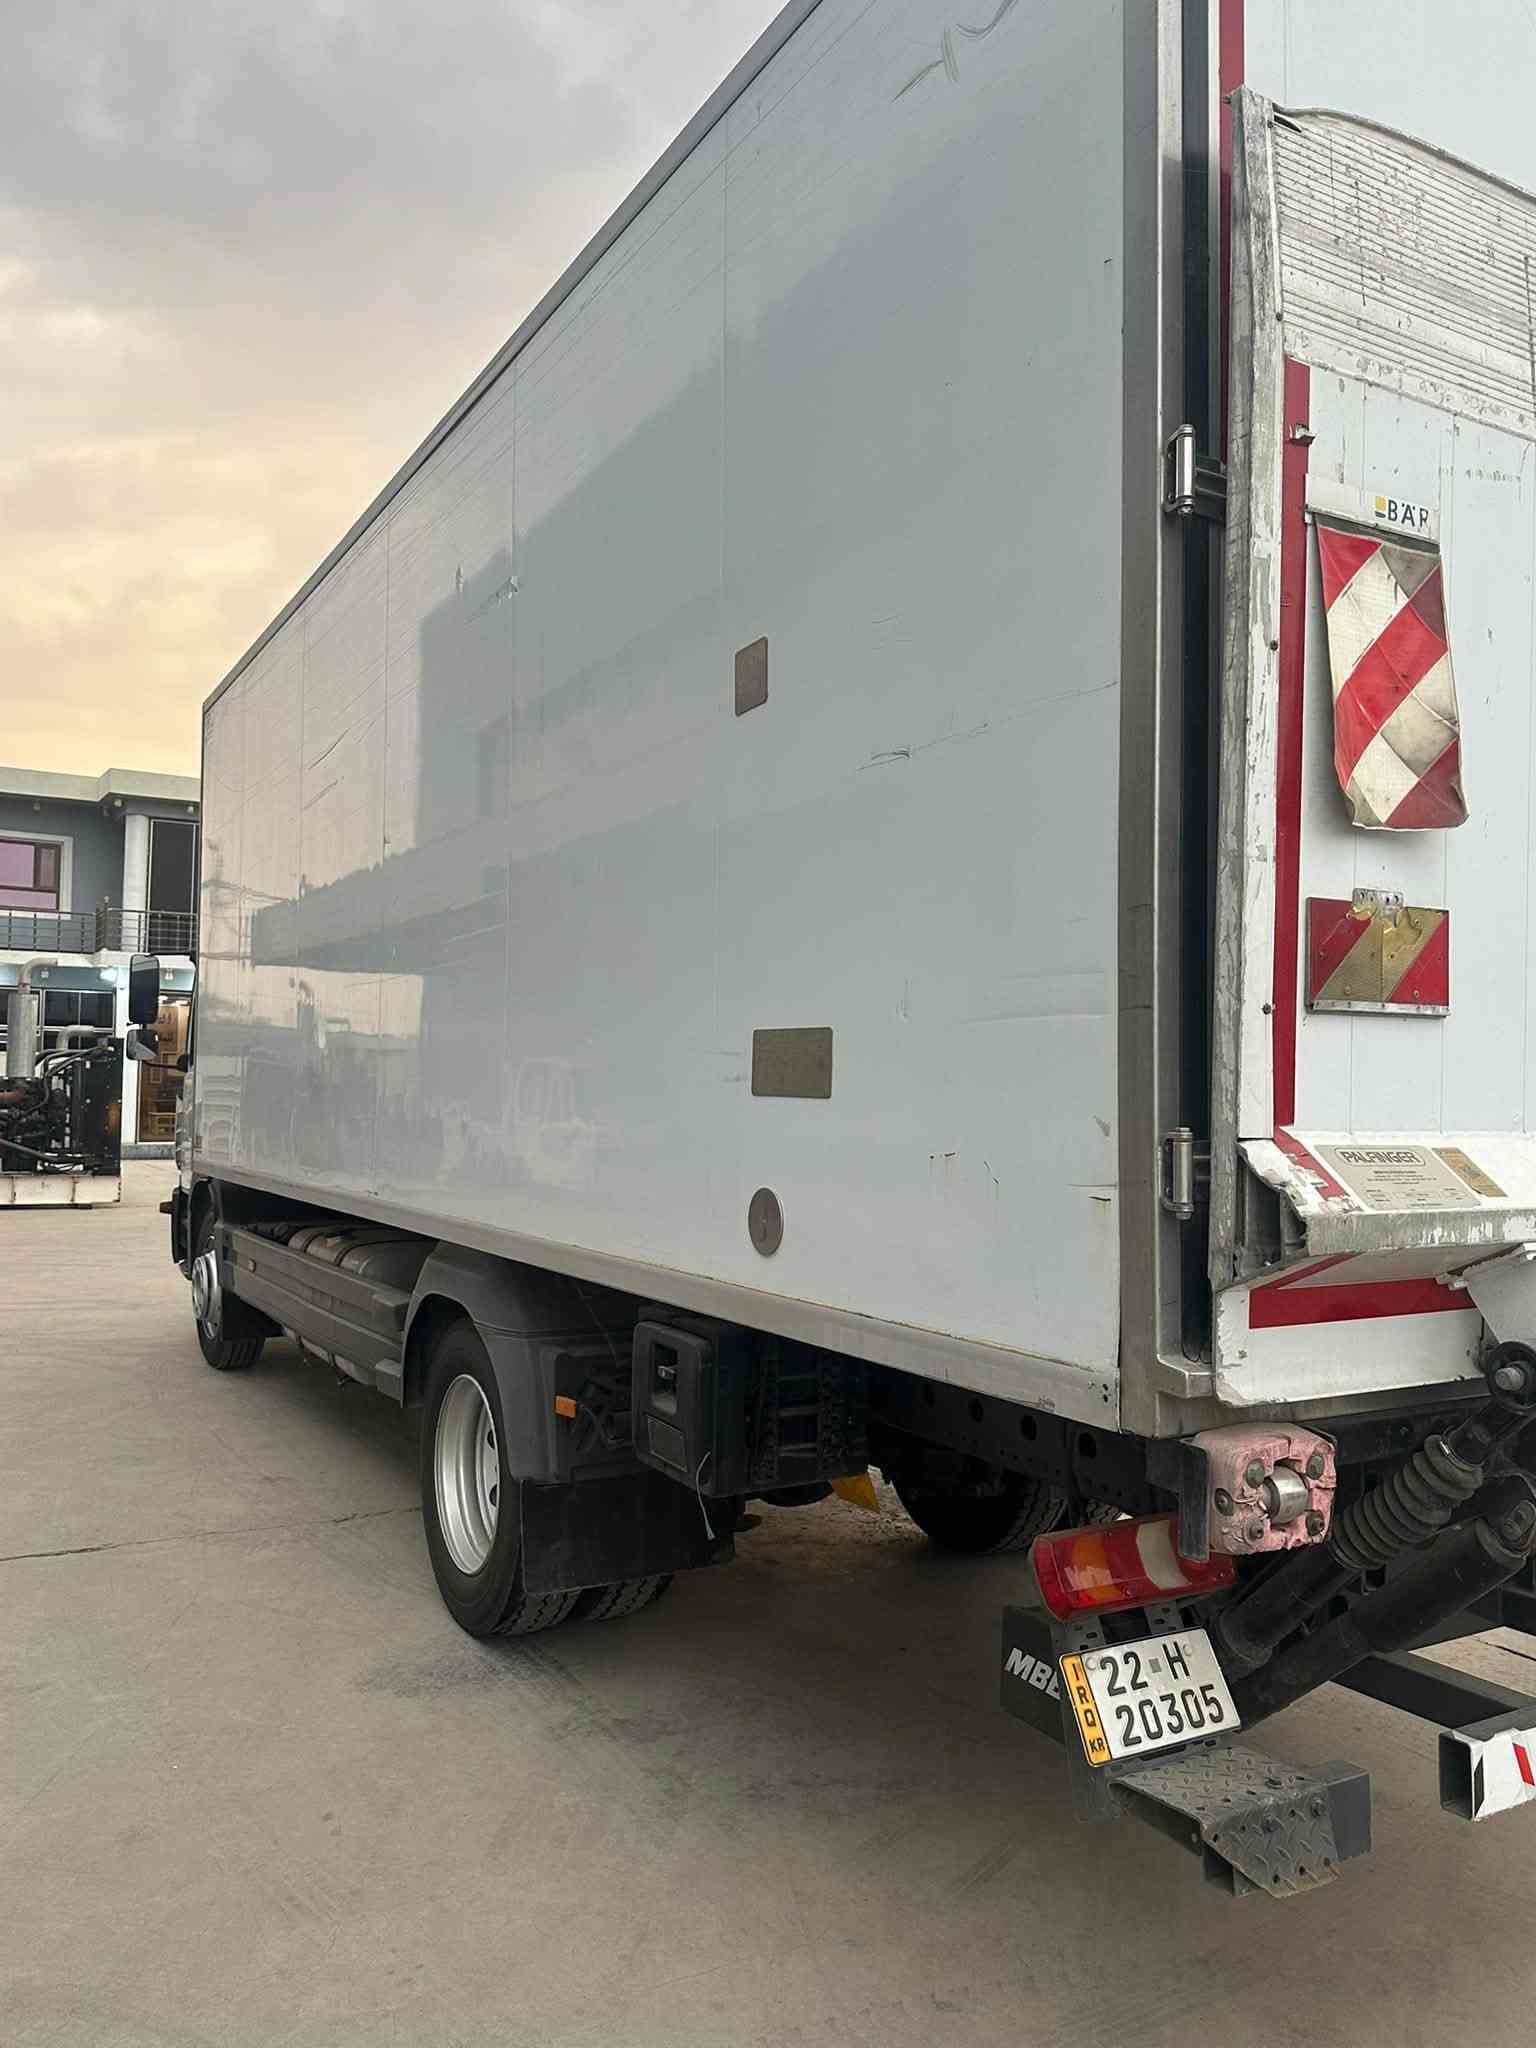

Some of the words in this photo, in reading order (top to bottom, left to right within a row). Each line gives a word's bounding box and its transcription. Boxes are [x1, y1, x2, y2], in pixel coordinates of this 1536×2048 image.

[1388, 499, 1429, 528] BÄR
[1341, 1151, 1421, 1164] PALFINGER
[1100, 1651, 1149, 1697] 22
[1162, 1641, 1190, 1680] H
[1116, 1684, 1225, 1746] 20305
[1089, 1738, 1106, 1755] KR
